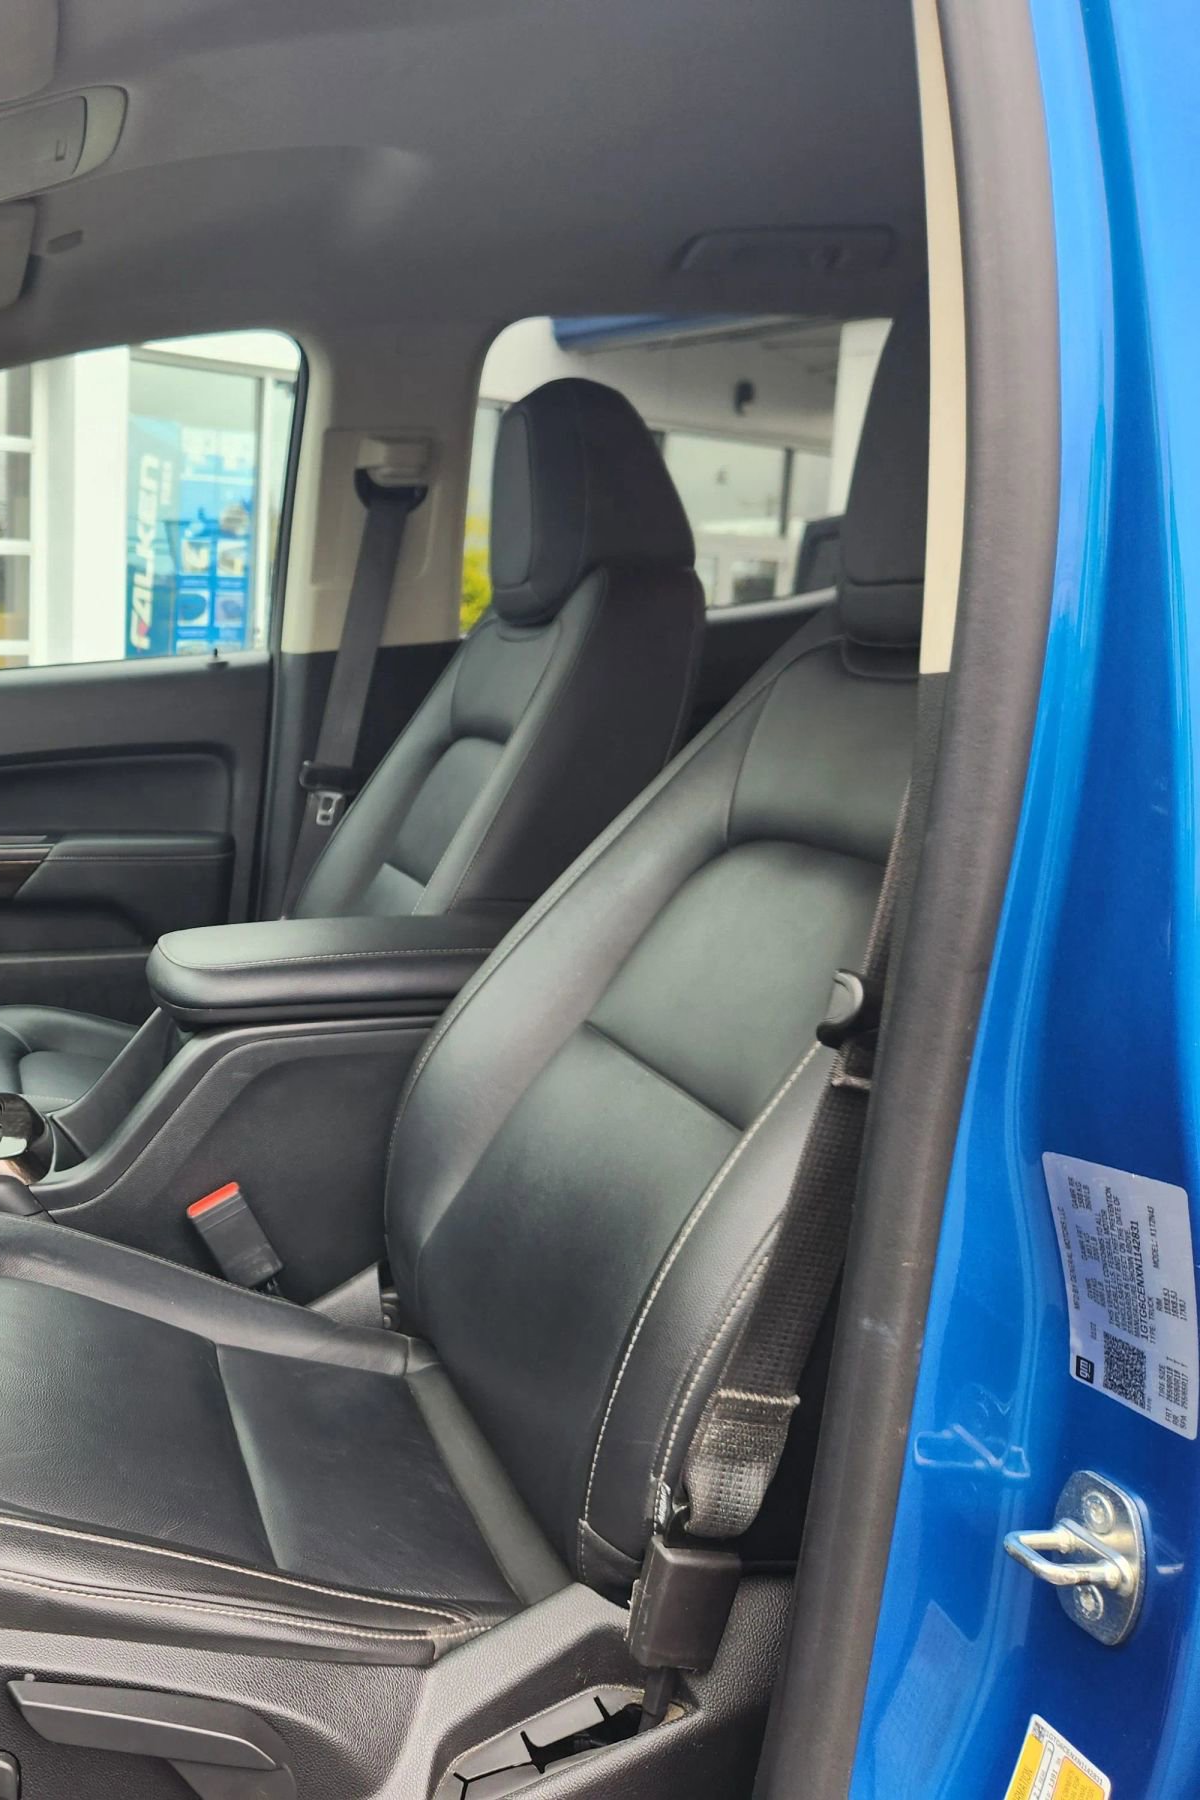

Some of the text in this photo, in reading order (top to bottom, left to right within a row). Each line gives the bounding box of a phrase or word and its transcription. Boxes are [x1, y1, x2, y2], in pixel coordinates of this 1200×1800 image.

[130, 455, 159, 650] FALKEN
[1105, 1186, 1115, 1231] PREVENTION
[1113, 1195, 1120, 1206] OF
[1101, 1209, 1109, 1235] MOTOR
[1115, 1207, 1123, 1226] DATE
[1062, 1222, 1071, 1249] MOTORS
[1119, 1243, 1126, 1253] ON
[1130, 1221, 1148, 1340] 1GTG6CENXN1142831
[1147, 1296, 1155, 1320] TRUCK
[1080, 1360, 1090, 1378] gm
